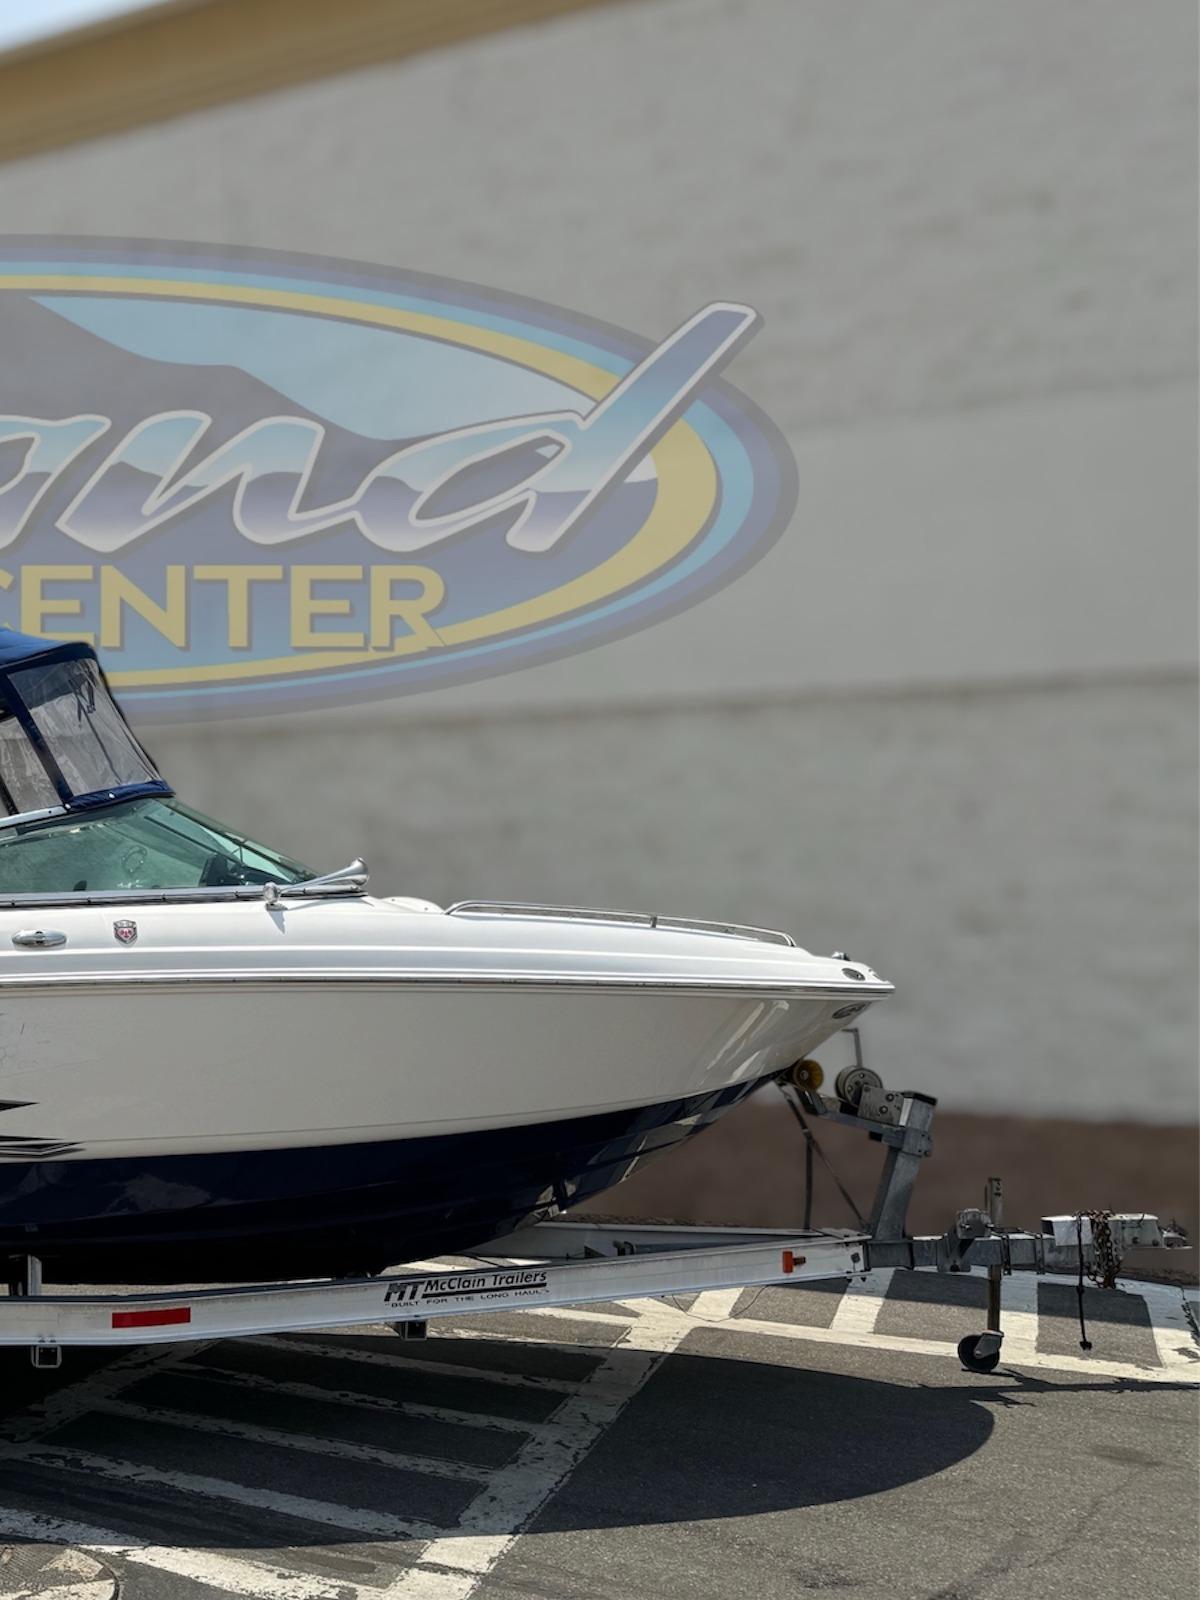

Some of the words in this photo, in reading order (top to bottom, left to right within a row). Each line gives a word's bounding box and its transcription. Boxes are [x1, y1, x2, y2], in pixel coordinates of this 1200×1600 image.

[424, 1276, 486, 1293] McClain
[492, 1271, 548, 1287] Trailers
[426, 1297, 448, 1305] FOR
[455, 1295, 474, 1303] THE
[480, 1291, 509, 1300] LONG
